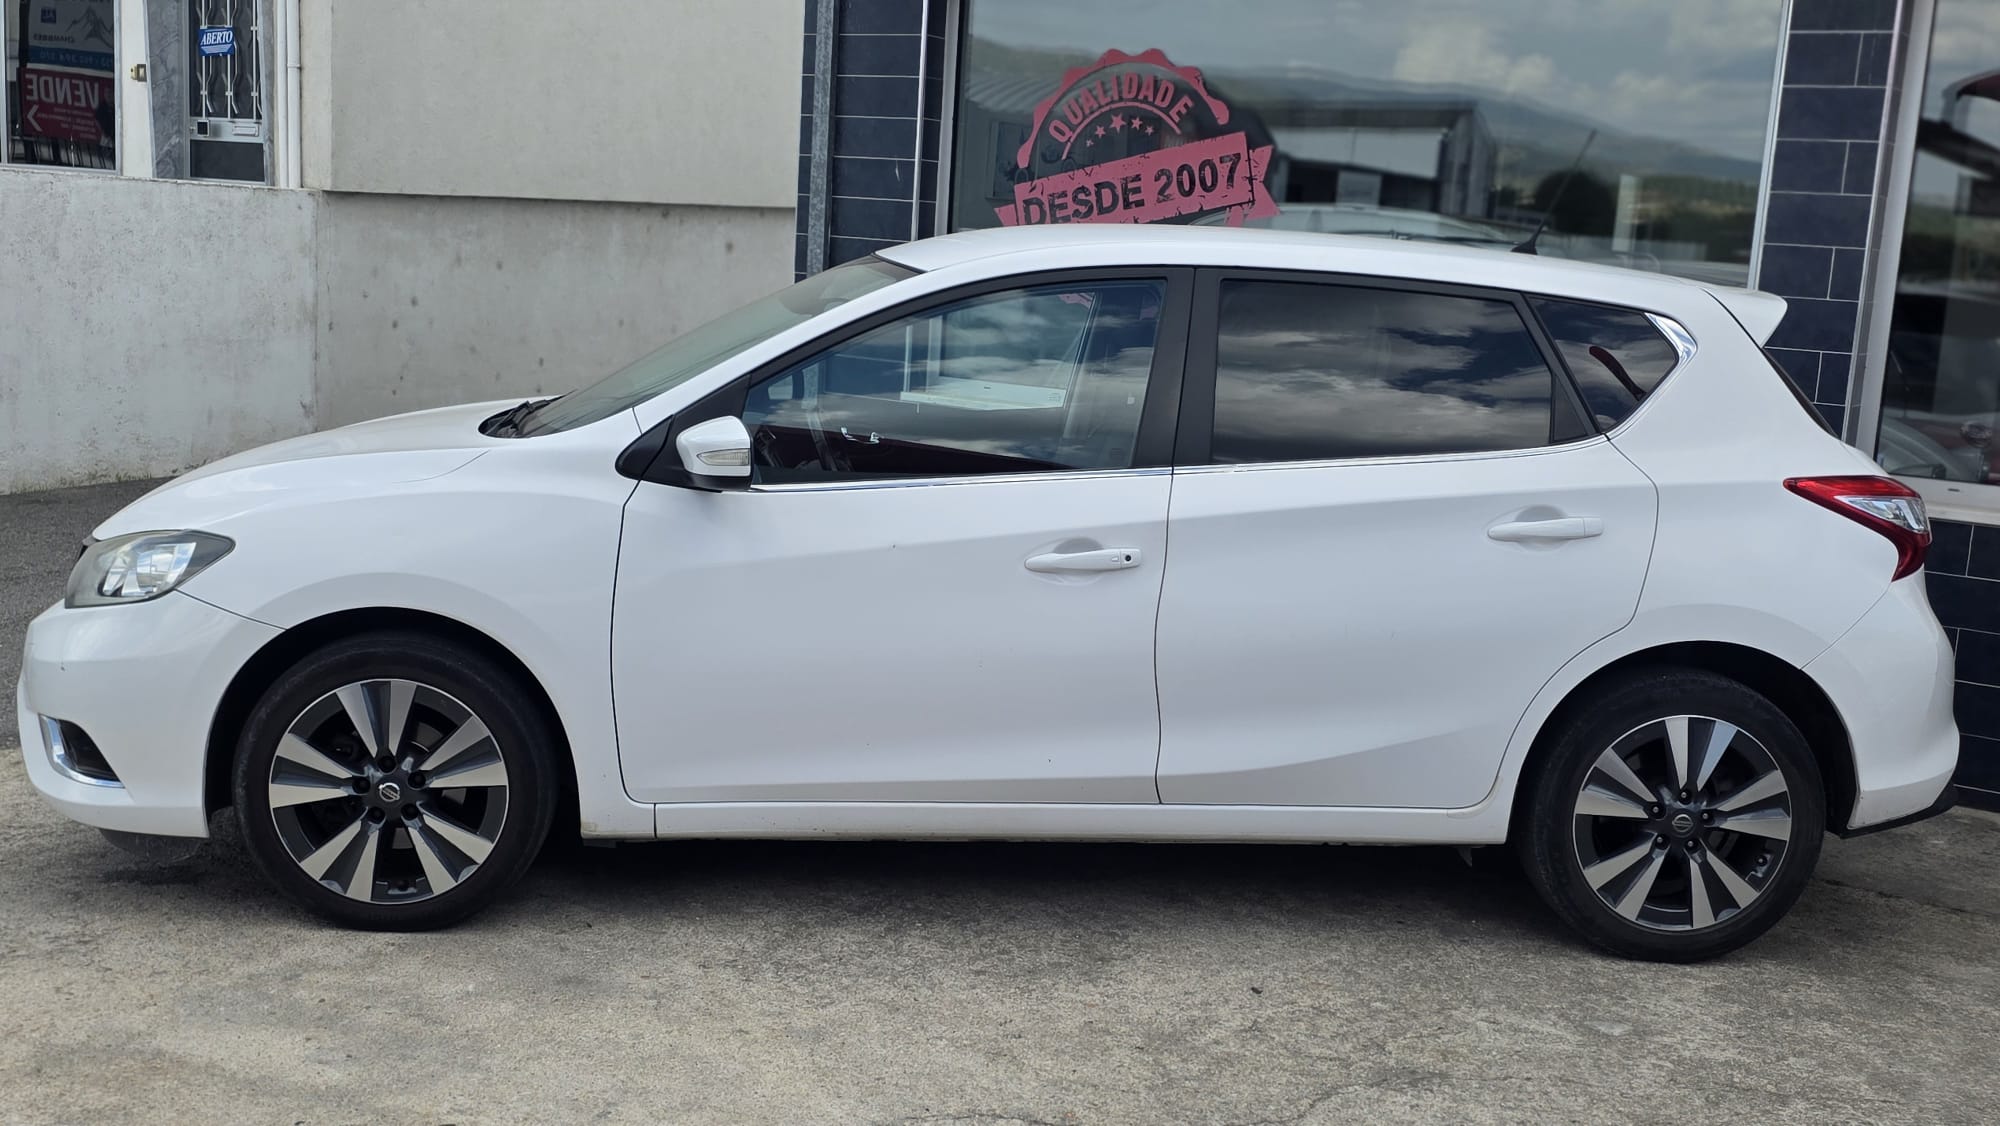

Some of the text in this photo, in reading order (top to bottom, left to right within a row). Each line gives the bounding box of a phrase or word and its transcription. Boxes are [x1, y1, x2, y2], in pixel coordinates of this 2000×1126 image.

[200, 30, 233, 46] ABERTO
[1048, 72, 1195, 143] QUALIDADE
[1023, 153, 1242, 225] DESDE 2007
